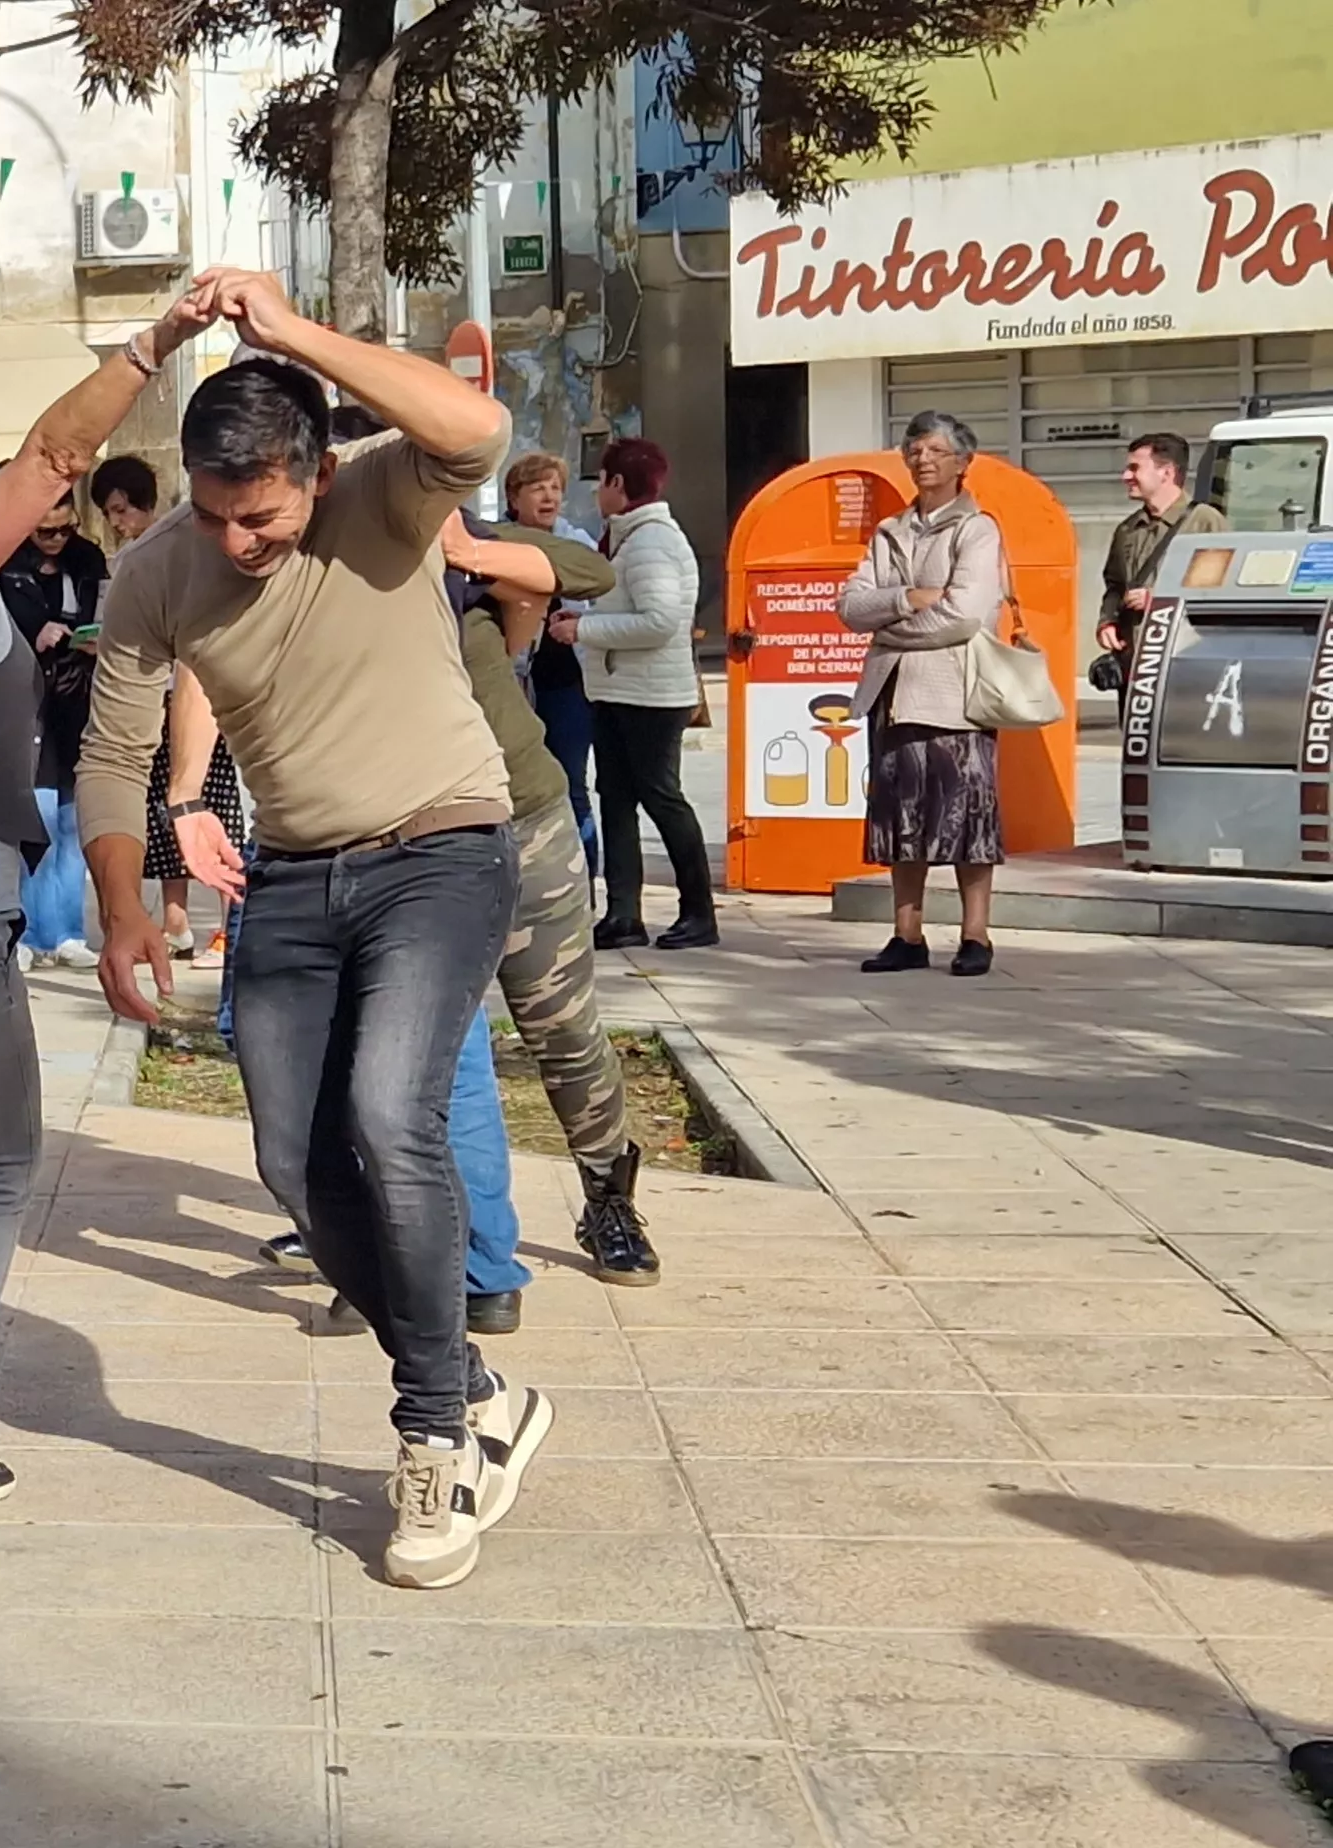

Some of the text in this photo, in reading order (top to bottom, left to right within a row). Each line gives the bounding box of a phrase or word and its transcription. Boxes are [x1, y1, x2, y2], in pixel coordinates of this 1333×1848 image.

[736, 199, 1166, 320] Tintorería
[986, 315, 1066, 342] Fundada
[1071, 313, 1088, 335] el
[1092, 313, 1127, 334] año
[756, 582, 835, 597] RECICLADO
[766, 596, 837, 612] DOMÉSTIC
[822, 633, 839, 645] EN
[793, 648, 810, 659] DE
[818, 661, 864, 674] CERRA
[1126, 605, 1175, 758] ORGANICA
[1202, 660, 1244, 736] A
